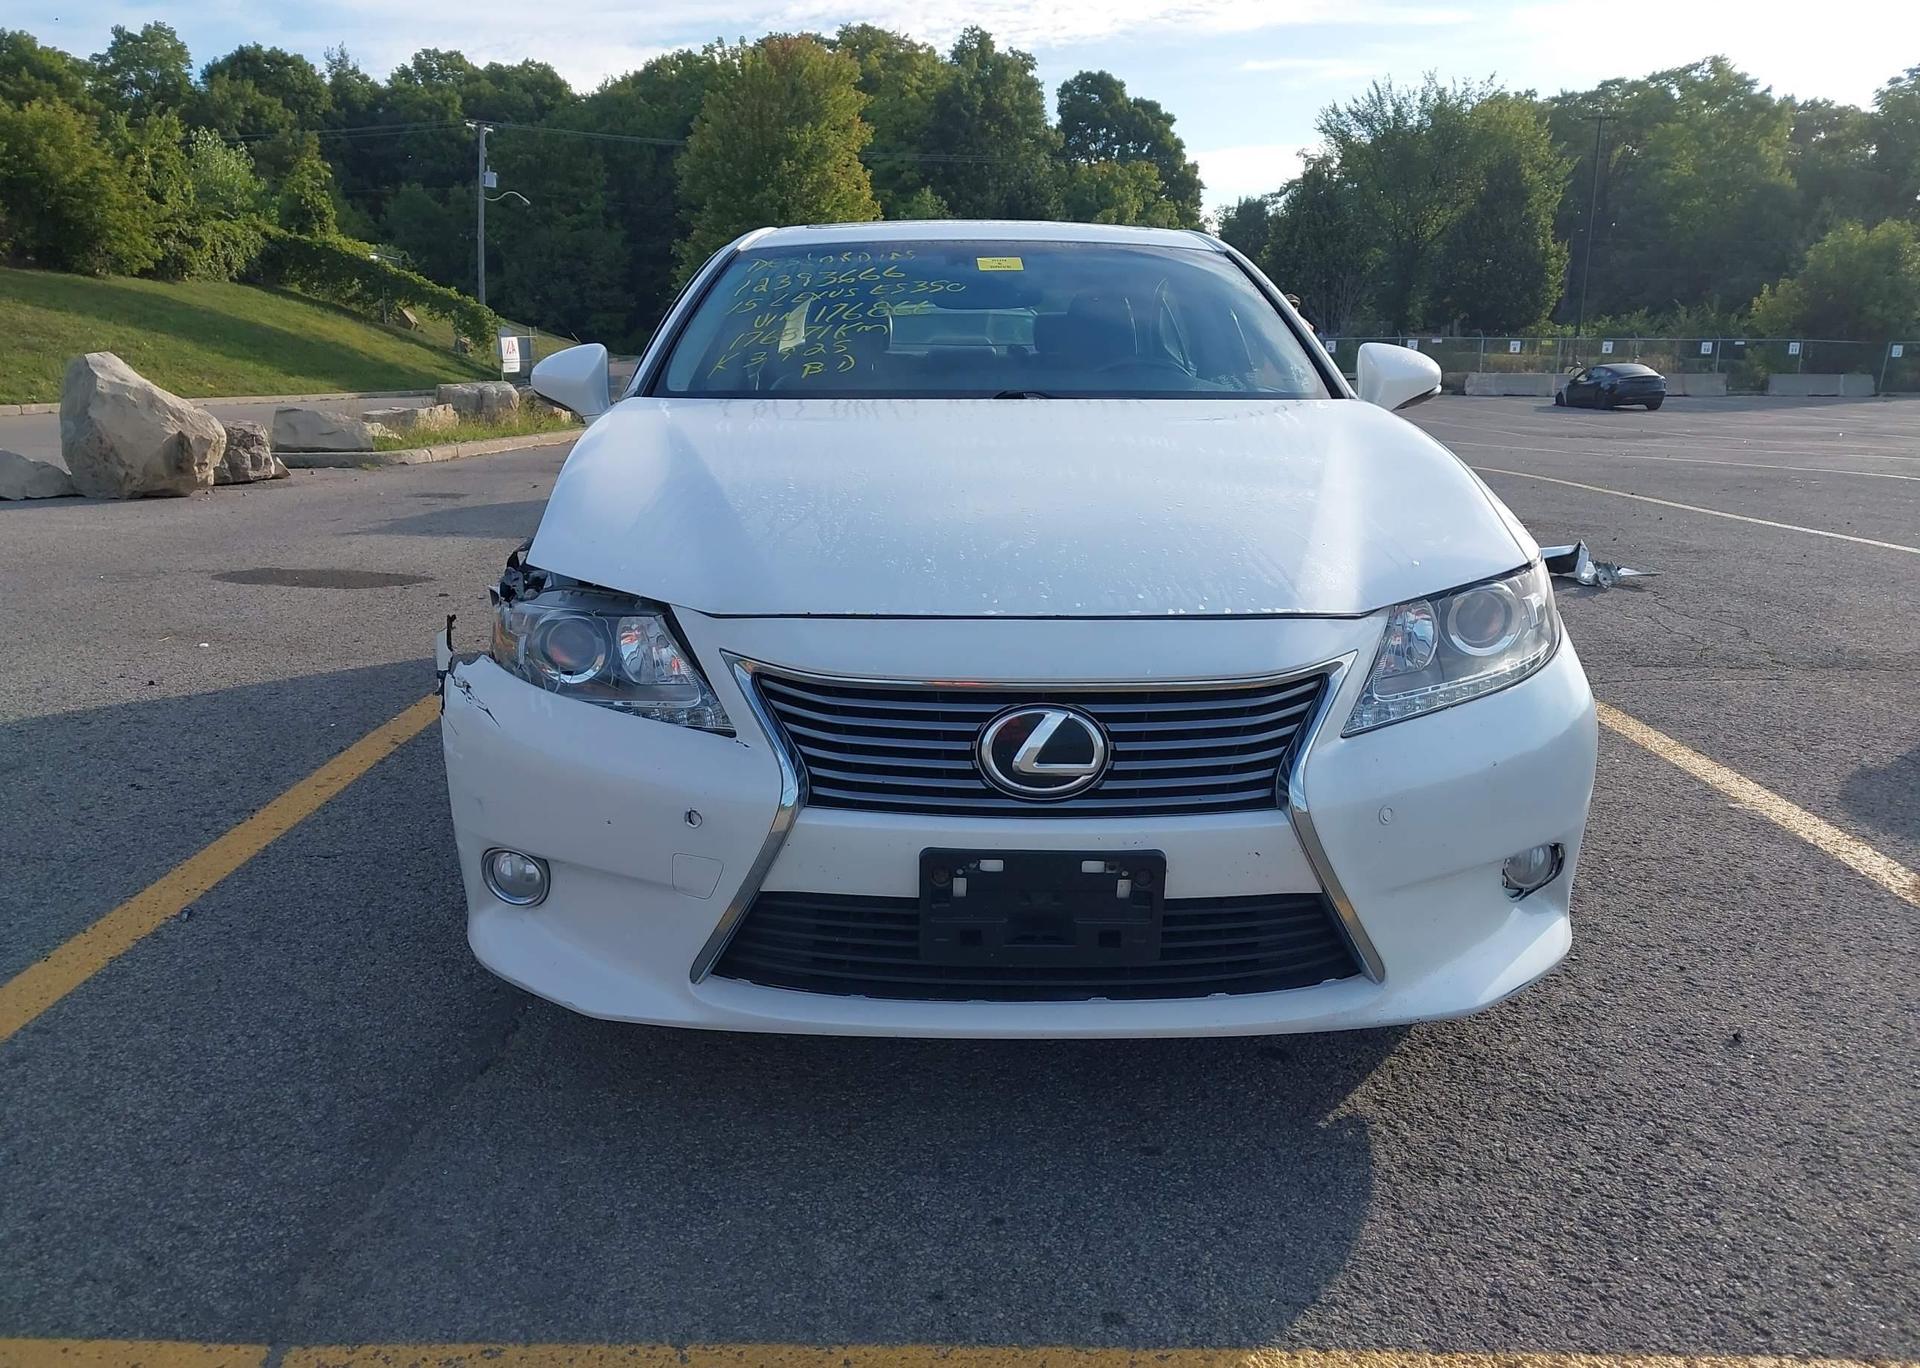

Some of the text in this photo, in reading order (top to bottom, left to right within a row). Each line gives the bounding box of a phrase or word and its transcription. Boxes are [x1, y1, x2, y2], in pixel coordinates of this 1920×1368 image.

[735, 265, 906, 297] 12393666
[770, 288, 859, 306] LEXUS
[869, 281, 967, 295] ES350
